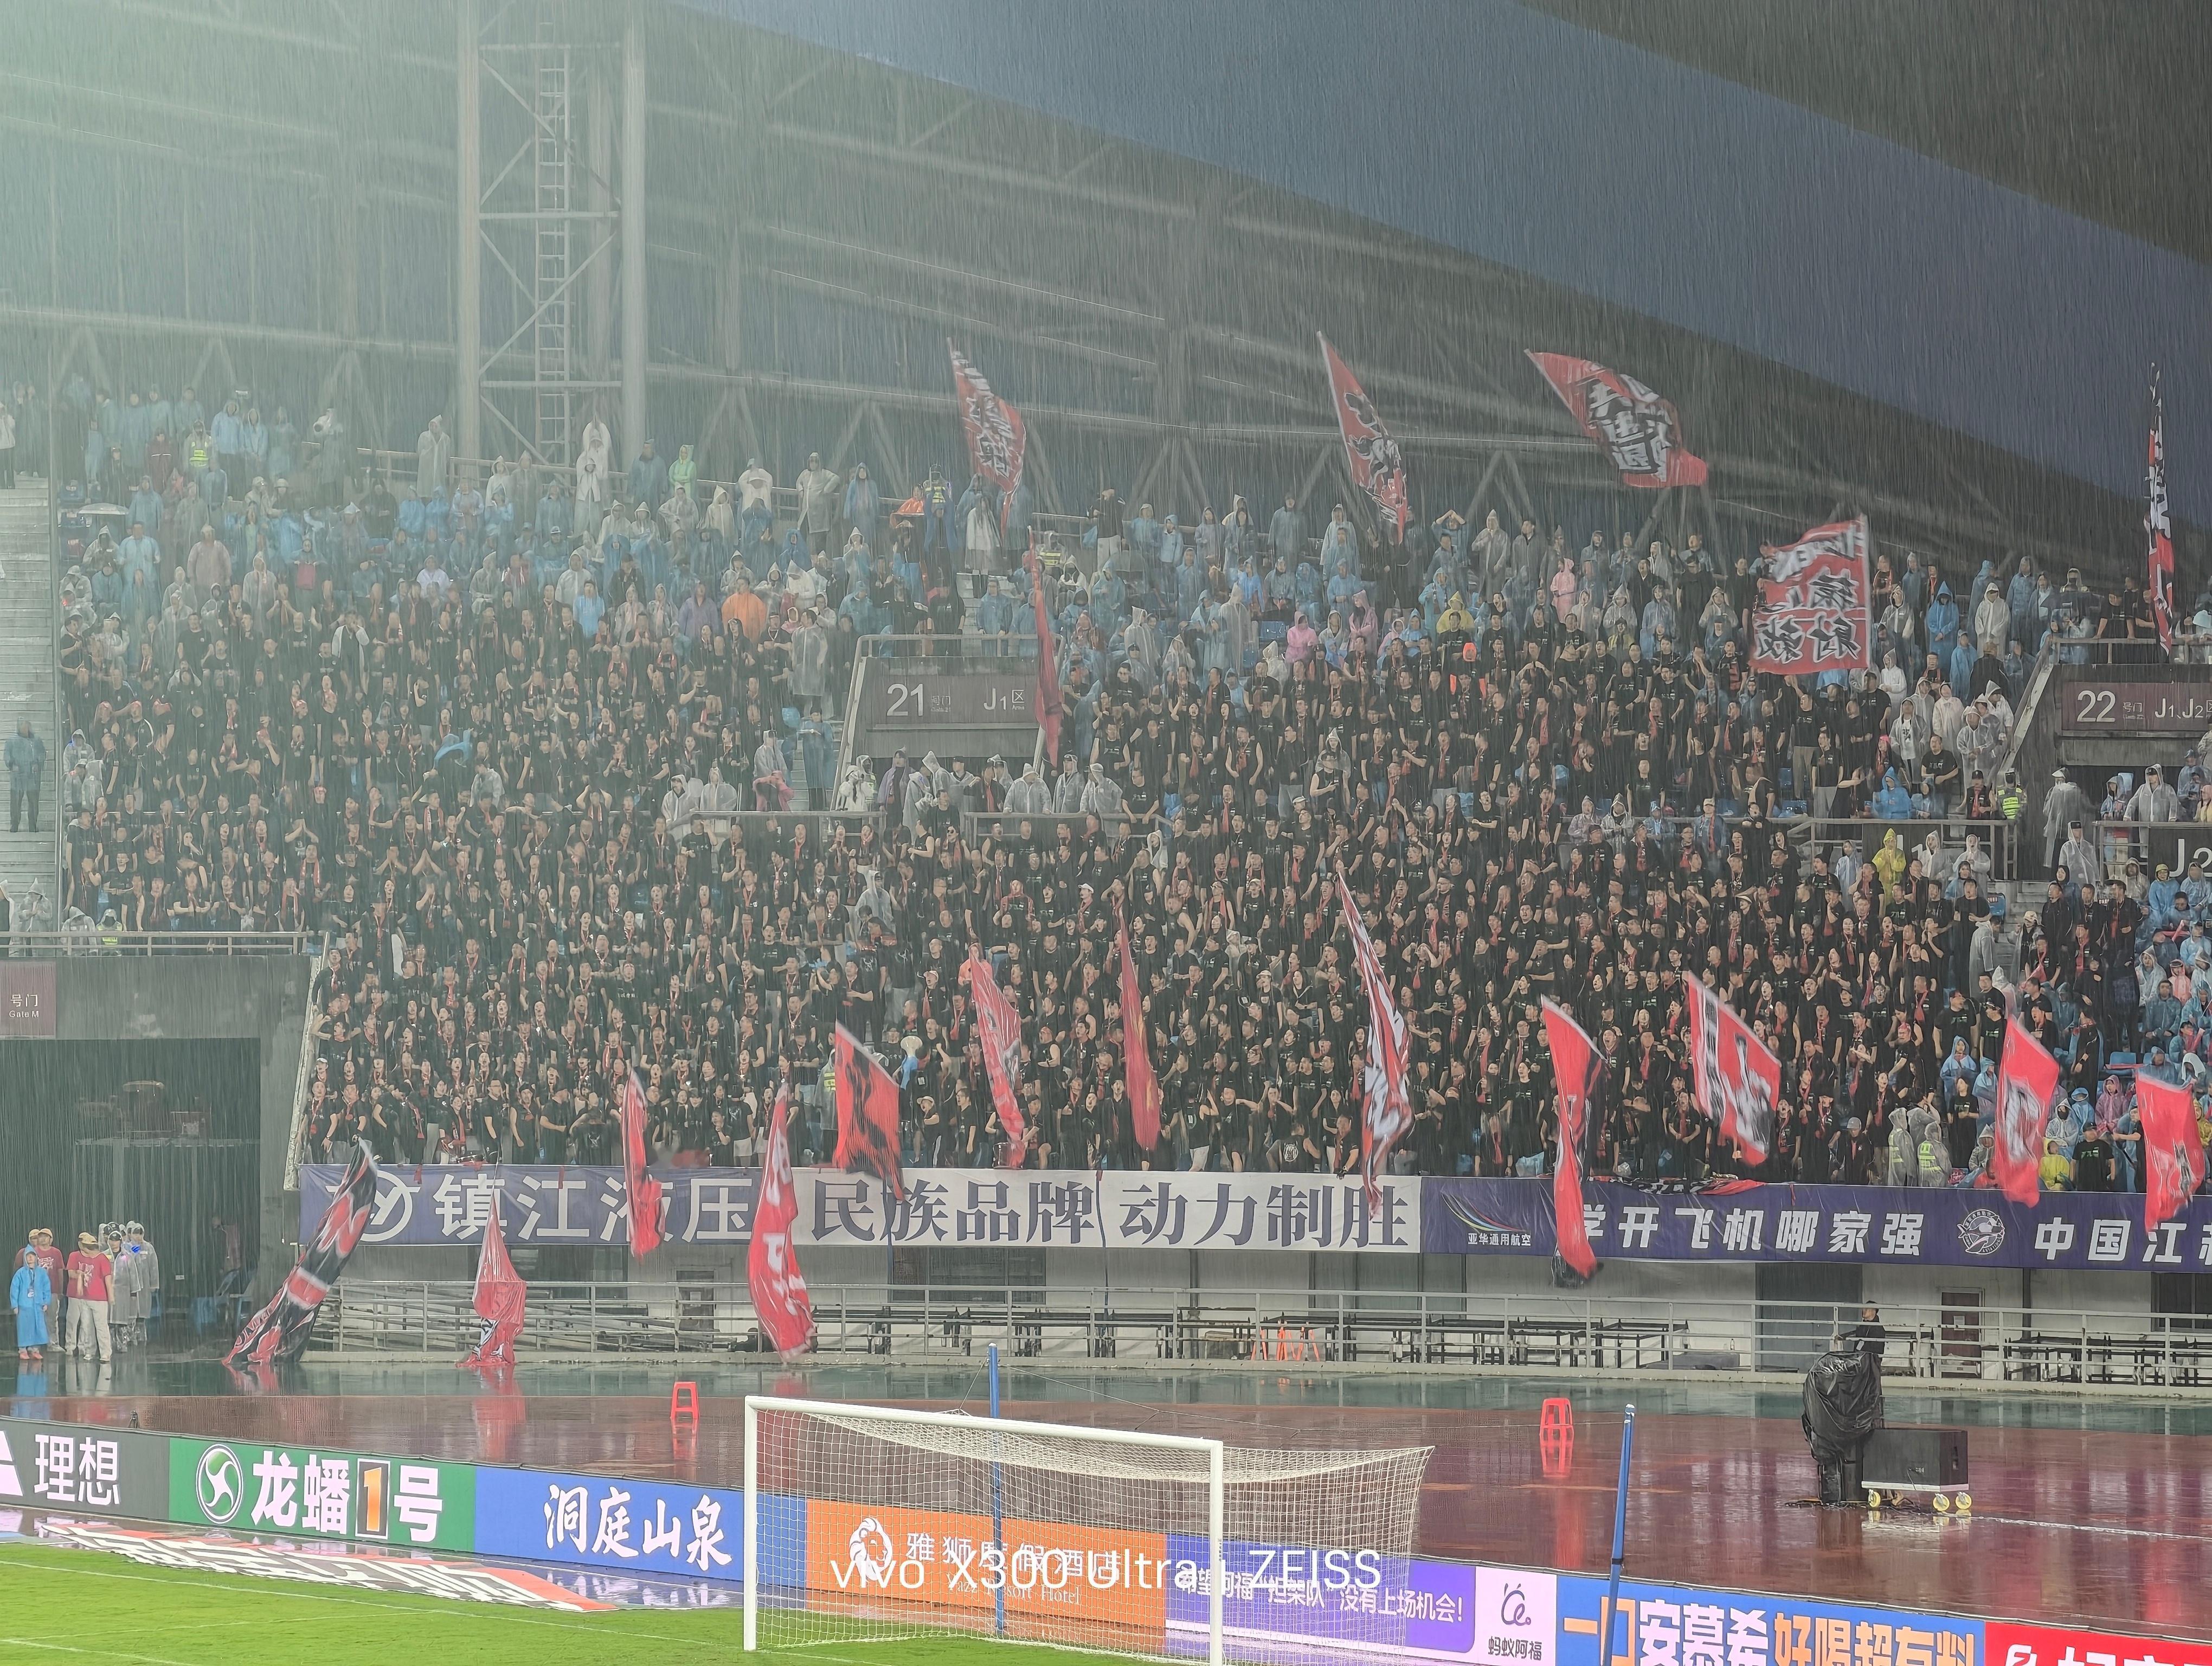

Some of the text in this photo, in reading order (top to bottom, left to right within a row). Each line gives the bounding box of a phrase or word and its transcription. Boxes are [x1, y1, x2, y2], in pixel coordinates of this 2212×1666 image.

[886, 683, 923, 716] 21
[2077, 690, 2115, 722] 22
[10, 994, 38, 1007] 号门
[34, 1432, 120, 1507] 理想
[543, 1483, 732, 1572] 洞庭山泉
[1488, 1636, 1542, 1661] 蚂蚁阿福
